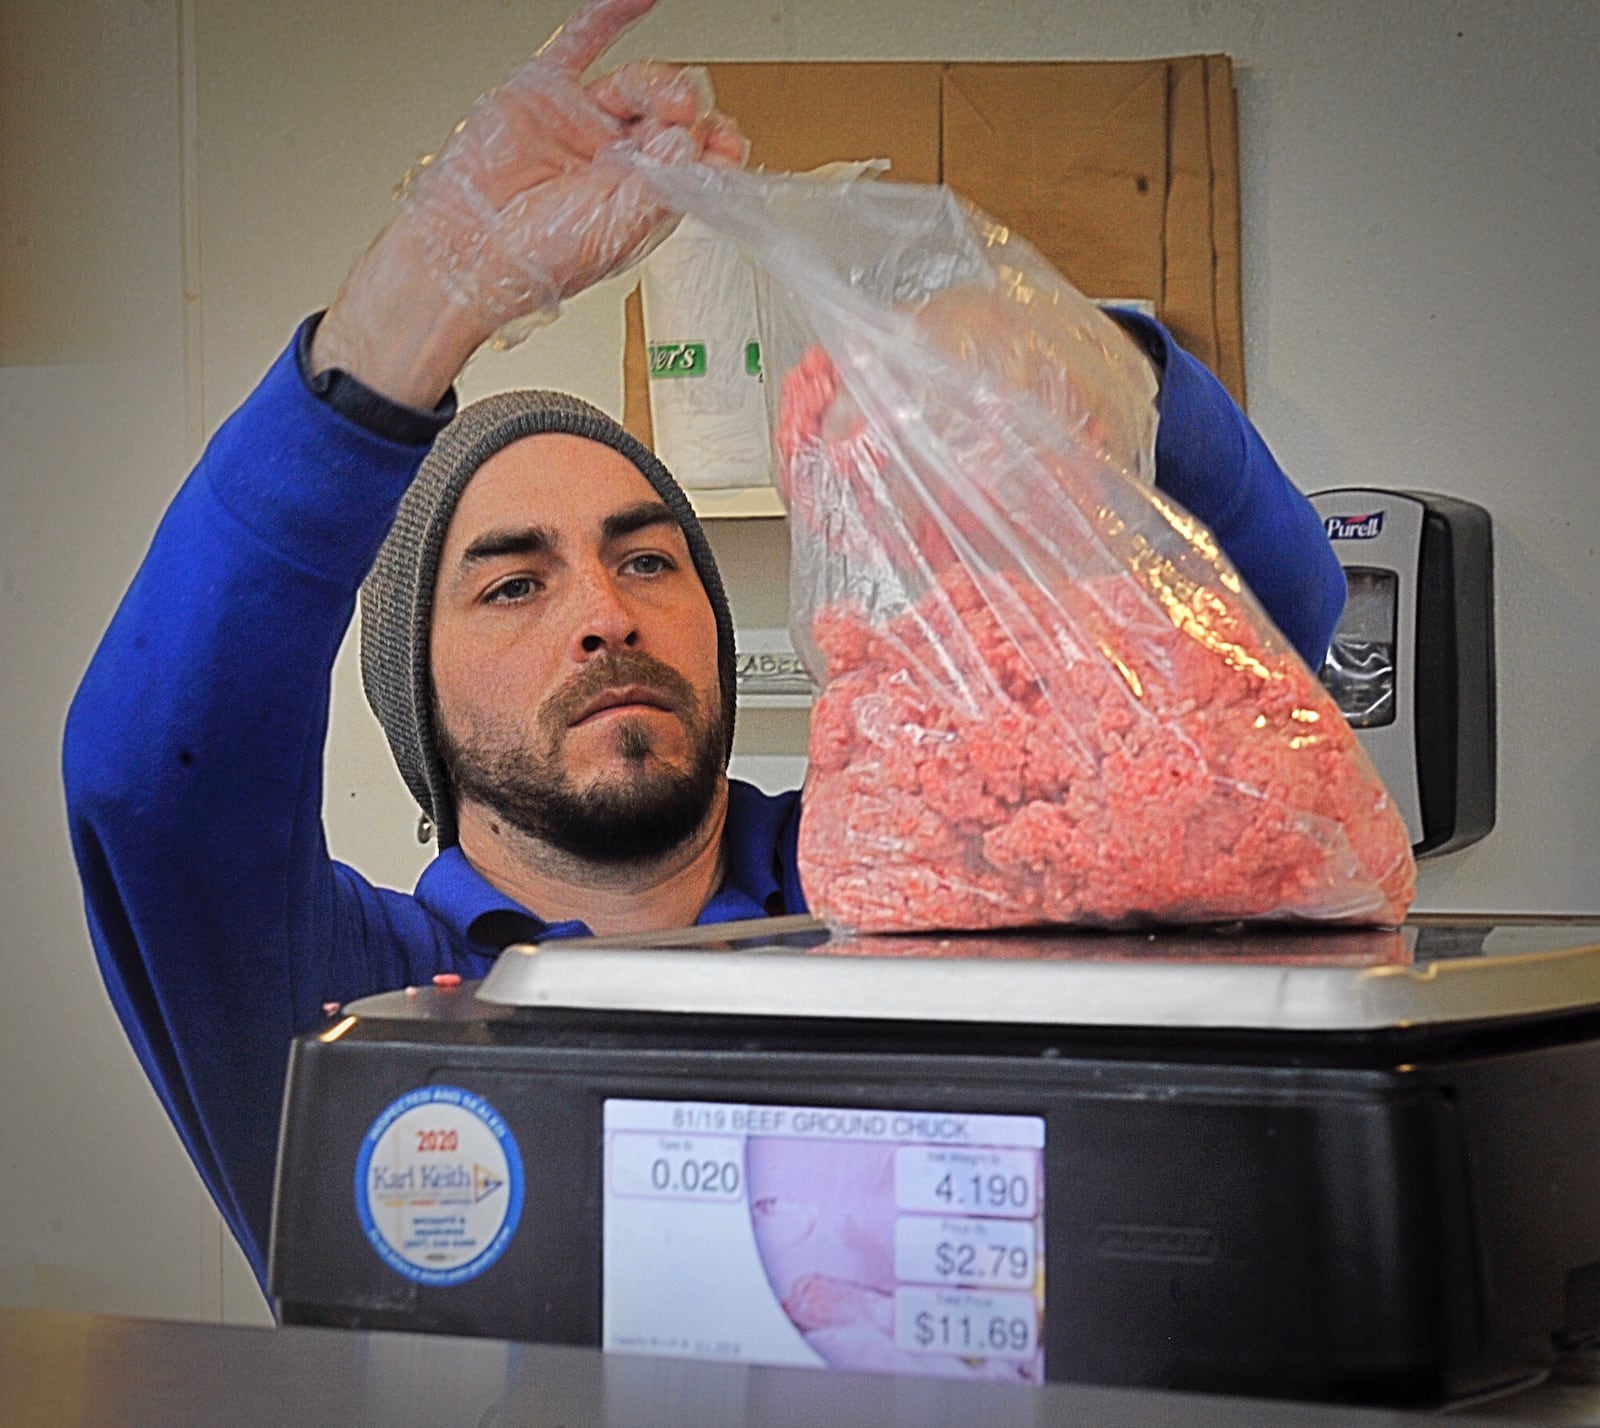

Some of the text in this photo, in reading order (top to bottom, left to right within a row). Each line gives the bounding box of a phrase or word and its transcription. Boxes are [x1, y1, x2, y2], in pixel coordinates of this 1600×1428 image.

[1327, 515, 1379, 538] Purell
[672, 1110, 969, 1138] 81/19 BEEF GROUND CHUCK
[416, 1129, 458, 1152] 2020
[373, 1165, 471, 1189] Karl Keith
[652, 1159, 739, 1193] 0.020
[935, 1173, 1029, 1207] 4.190
[935, 1241, 1028, 1280] $2.79
[915, 1311, 1028, 1351] $11.69
